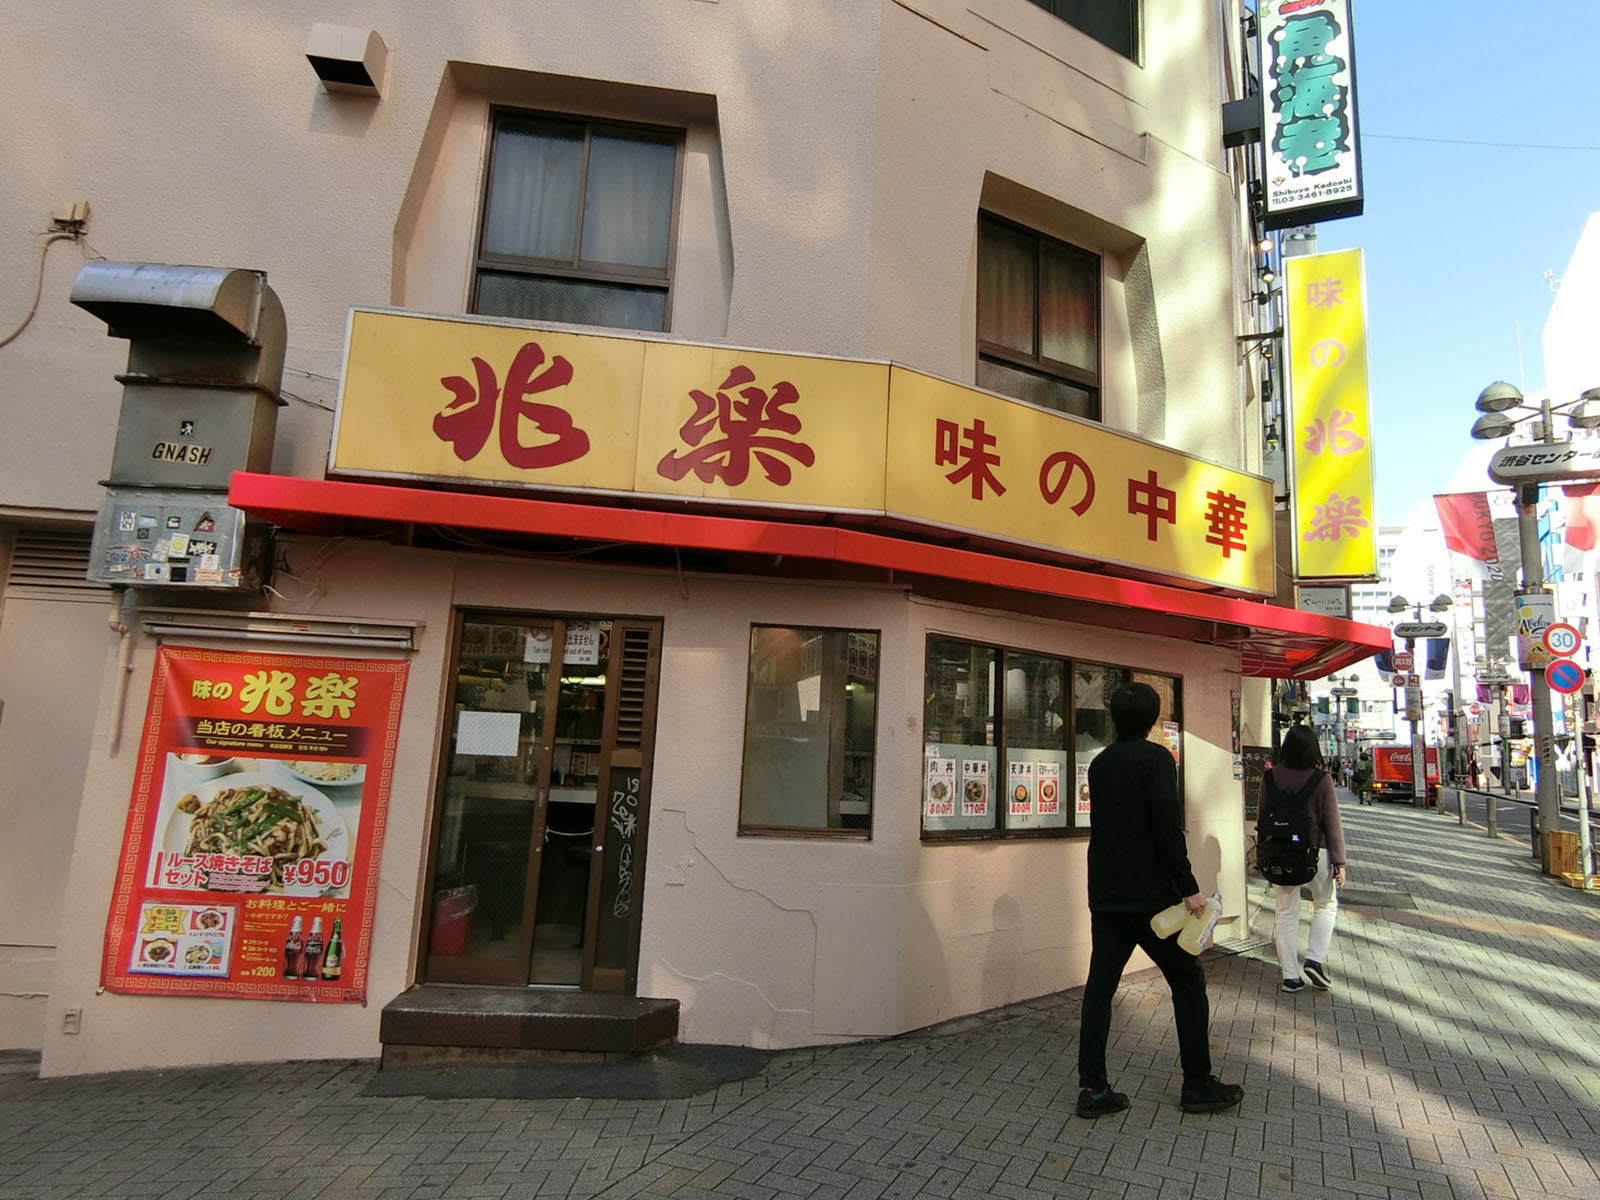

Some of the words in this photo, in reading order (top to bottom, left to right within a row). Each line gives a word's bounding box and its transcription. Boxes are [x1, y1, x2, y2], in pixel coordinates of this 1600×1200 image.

[1272, 186, 1310, 198] Shibuya
[432, 341, 816, 487] 兆楽
[1302, 275, 1370, 542] 味の兆楽
[152, 442, 213, 465] GNASH
[934, 417, 1249, 559] 味の中華
[1551, 632, 1574, 648] 30
[196, 719, 348, 742] 当店の看板メニュー
[964, 762, 987, 775] 中華丼
[963, 803, 985, 815] 770円
[167, 851, 273, 874] ルース焼きそば
[164, 870, 208, 887] セット
[283, 859, 349, 887] ¥950
[245, 898, 348, 914] お料理とご一緒に
[251, 966, 276, 978] ¥200
